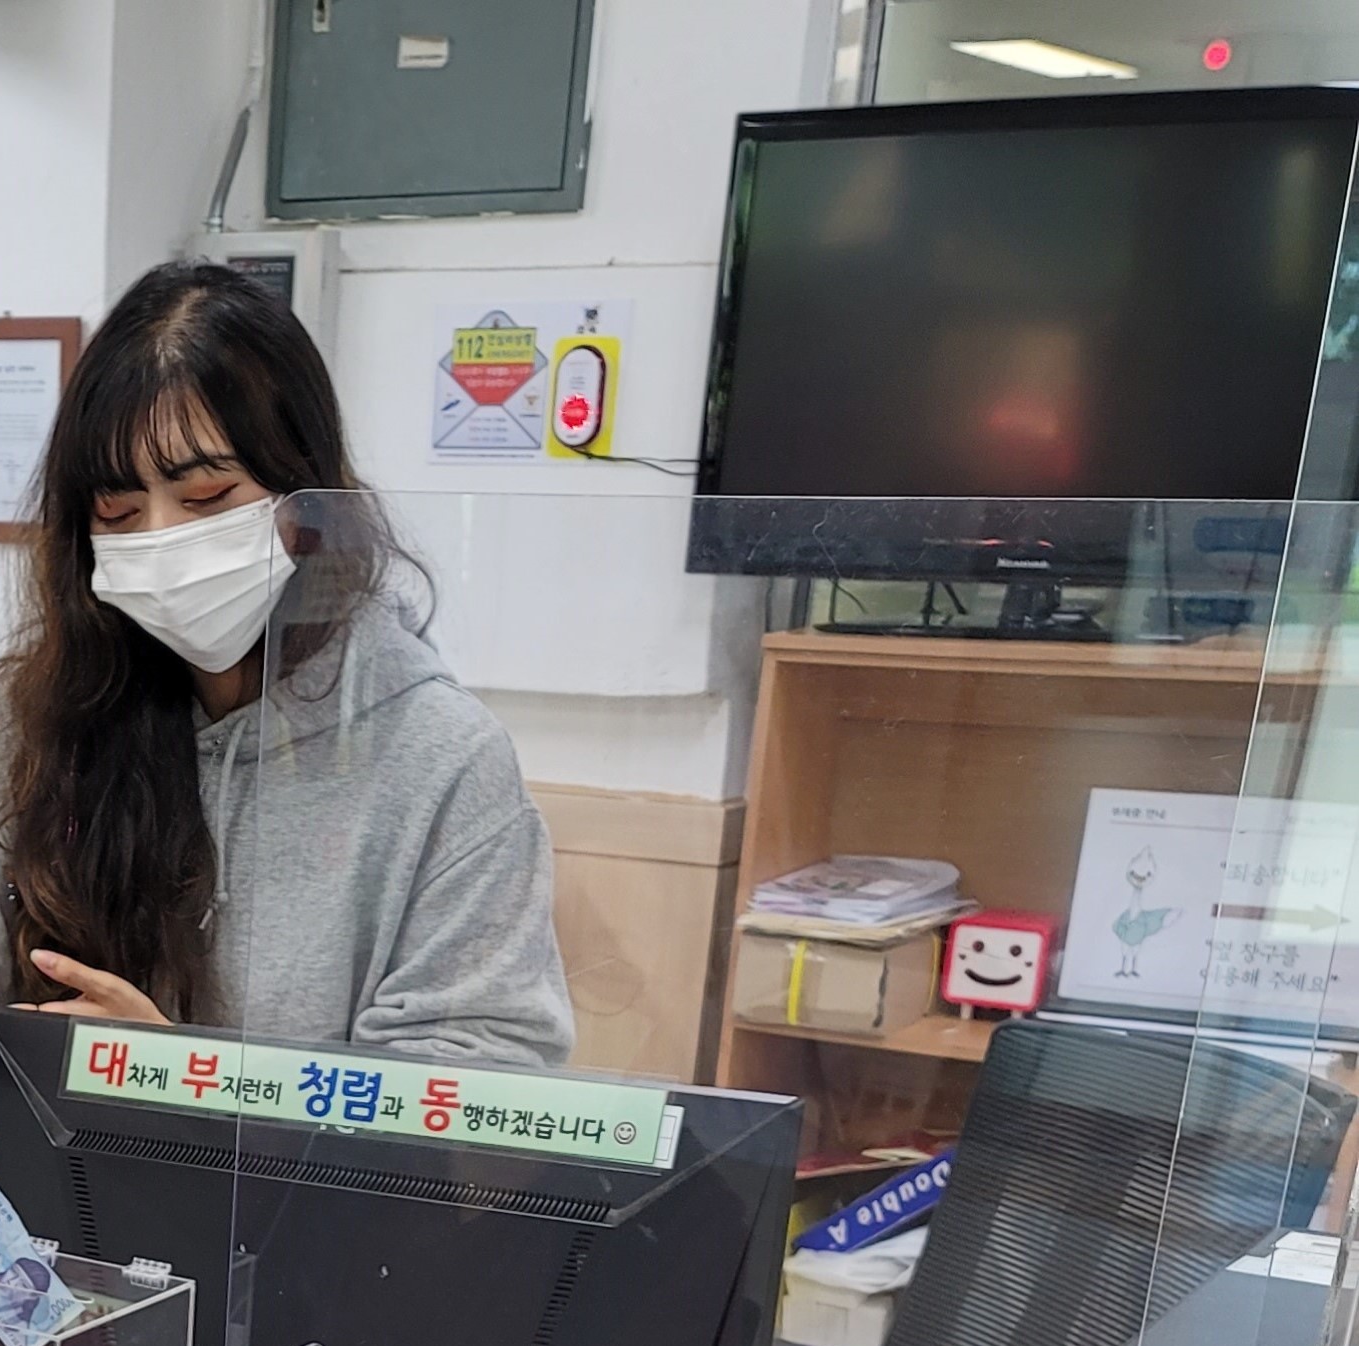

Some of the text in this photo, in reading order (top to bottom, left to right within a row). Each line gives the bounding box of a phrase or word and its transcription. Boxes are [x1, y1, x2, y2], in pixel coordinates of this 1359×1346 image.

[457, 335, 484, 359] 112
[89, 1041, 606, 1145] 대차게 부지런히 청렴과 동행하겠습니다
[826, 1158, 952, 1246] Double A
